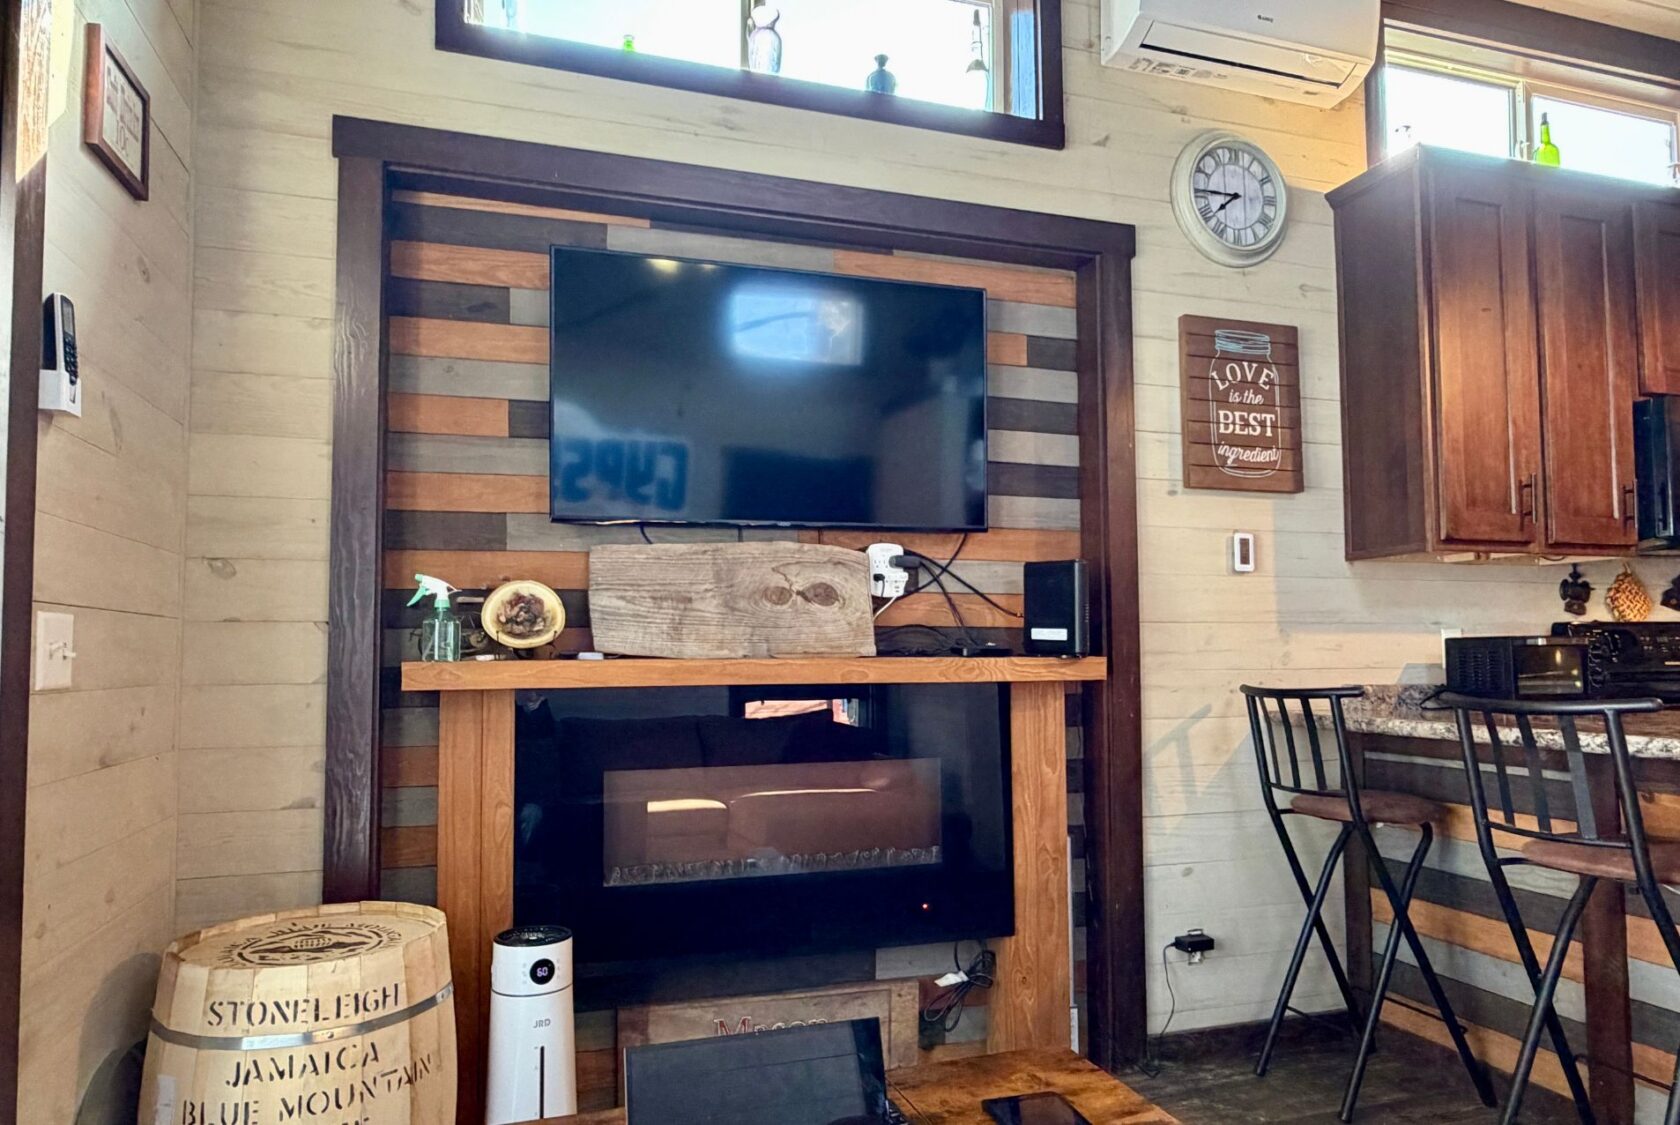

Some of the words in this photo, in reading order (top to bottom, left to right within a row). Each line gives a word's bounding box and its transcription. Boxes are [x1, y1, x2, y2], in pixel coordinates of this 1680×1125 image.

[1211, 362, 1274, 390] LOVE
[1229, 389, 1242, 403] is
[1242, 388, 1264, 405] the
[1218, 410, 1276, 437] BEST
[1217, 441, 1280, 466] ingredient
[536, 967, 548, 977] 60
[207, 982, 400, 1027] STONELEIGH
[533, 1018, 551, 1029] JRD
[225, 1042, 380, 1087] JAMAICA
[182, 1099, 260, 1125] BLUE
[278, 1053, 433, 1119] MOUNTAIN
